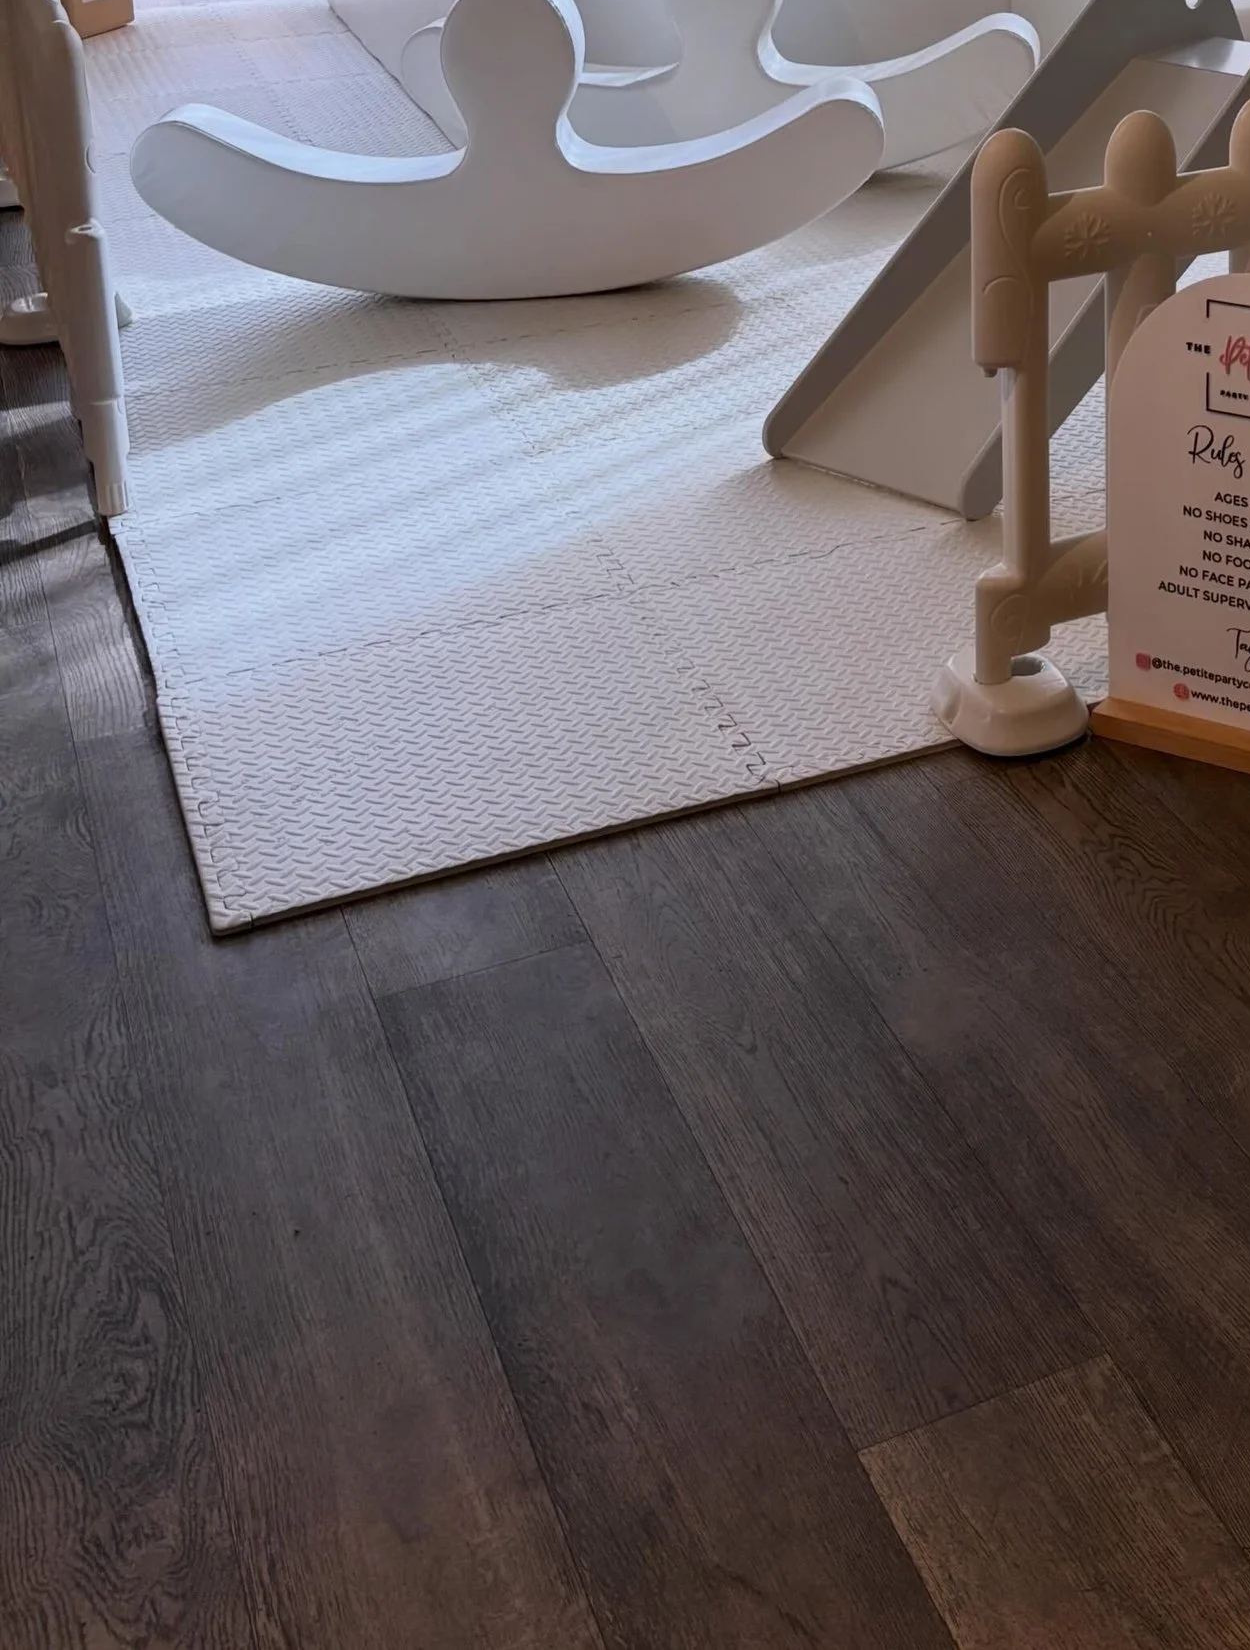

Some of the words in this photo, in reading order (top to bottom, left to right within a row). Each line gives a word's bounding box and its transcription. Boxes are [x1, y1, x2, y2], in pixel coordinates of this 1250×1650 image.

[1186, 342, 1211, 354] THE
[1220, 390, 1248, 401] PARTY
[1187, 425, 1245, 479] Rules
[1214, 492, 1248, 507] AGES
[1183, 505, 1202, 518] NO
[1205, 510, 1248, 528] SHOES
[1203, 530, 1223, 543] NO
[1202, 550, 1222, 563] NO
[1179, 565, 1198, 578] NO
[1202, 570, 1234, 586] FACE
[1158, 581, 1200, 599] ADULT
